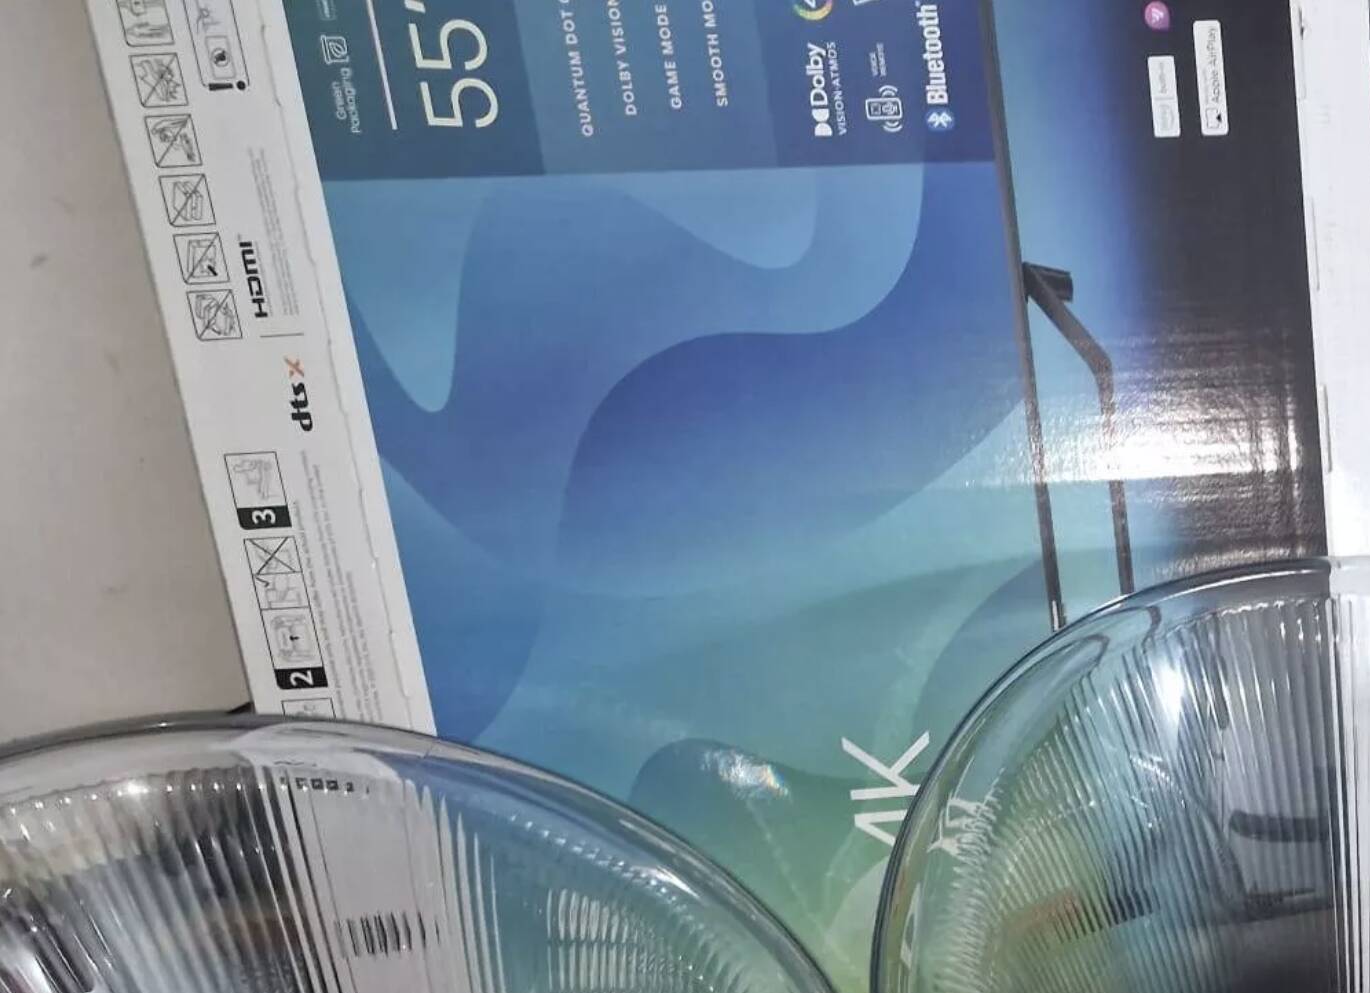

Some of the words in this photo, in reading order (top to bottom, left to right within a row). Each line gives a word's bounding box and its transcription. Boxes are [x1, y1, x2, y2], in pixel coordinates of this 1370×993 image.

[560, 9, 578, 45] DOT
[655, 4, 674, 55] MODE
[917, 4, 949, 104] Bluetooth
[568, 51, 594, 137] QUANTUM
[617, 60, 637, 116] DOLBY
[664, 61, 683, 110] GAME
[707, 33, 728, 107] SMOOTH
[806, 42, 828, 106] Dolby
[239, 241, 268, 318] HDMI
[252, 508, 276, 524] 3
[290, 669, 314, 687] 2
